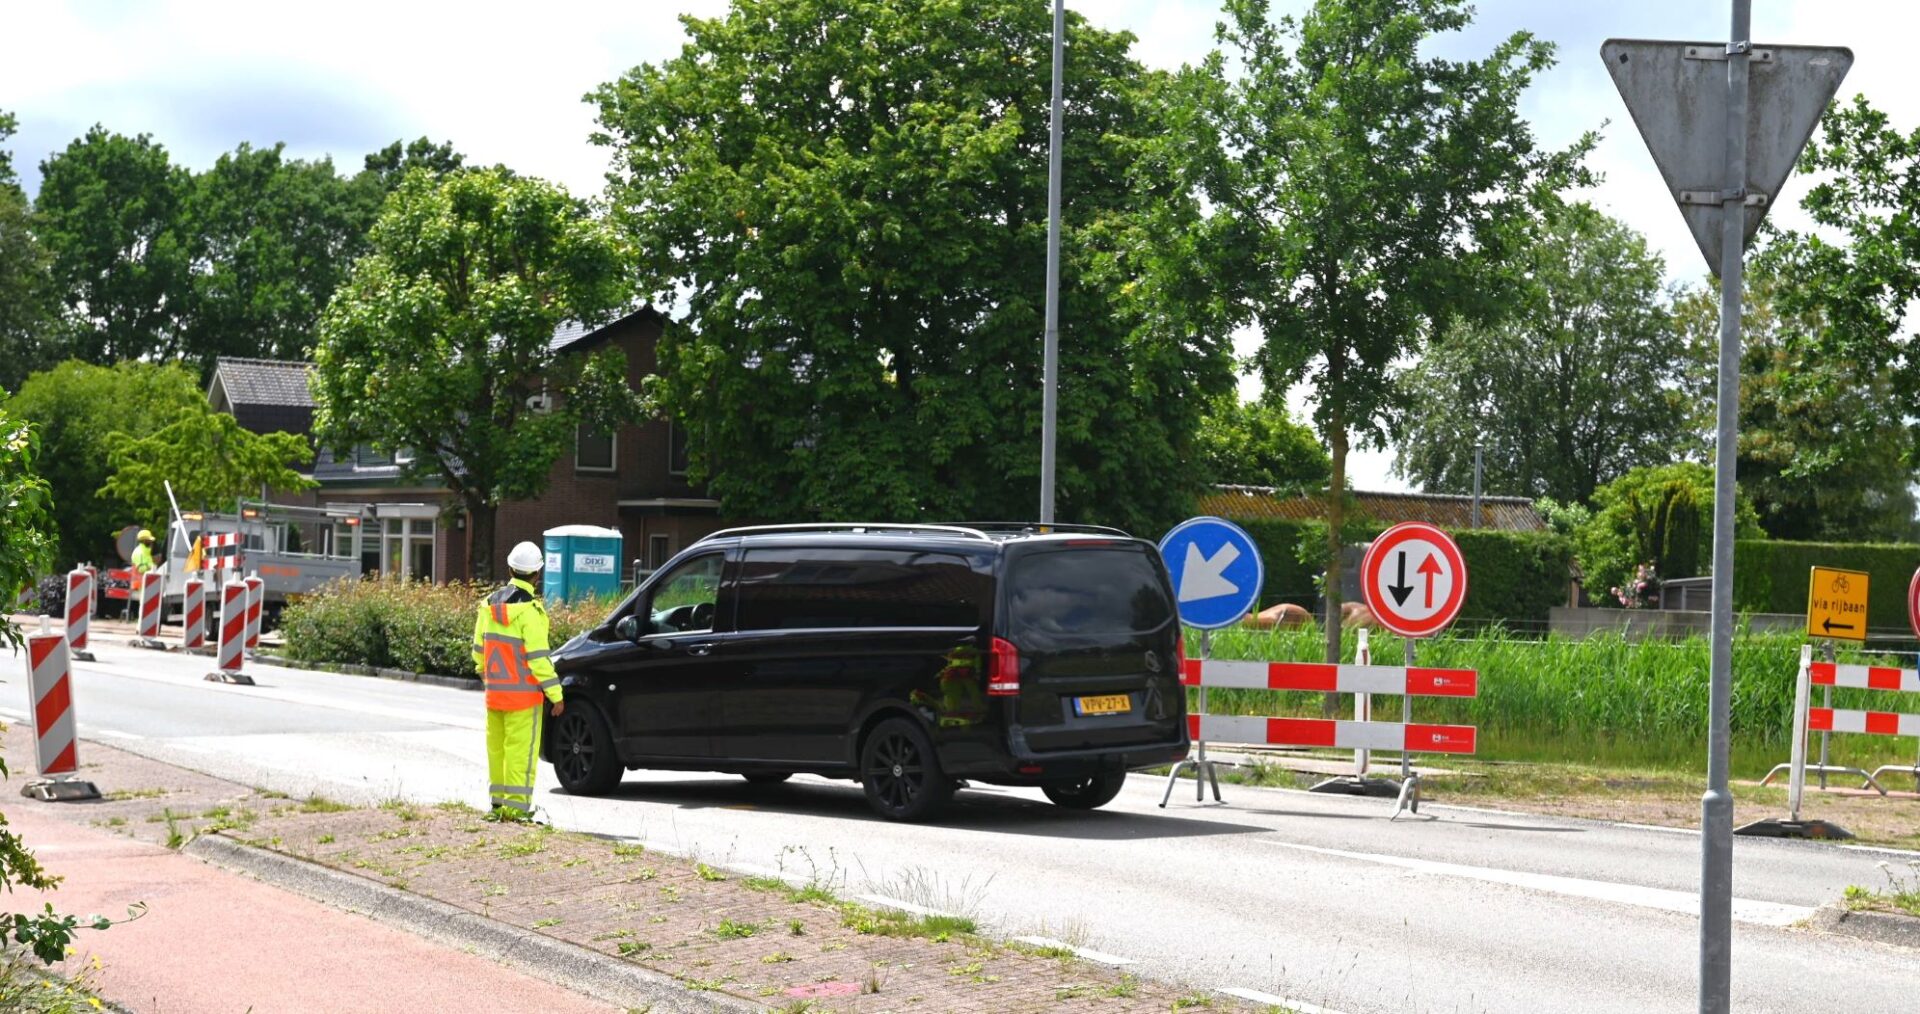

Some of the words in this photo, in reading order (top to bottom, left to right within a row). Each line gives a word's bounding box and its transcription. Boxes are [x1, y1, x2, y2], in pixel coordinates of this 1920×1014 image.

[585, 557, 604, 565] DIXI
[1814, 598, 1828, 609] via
[1831, 599, 1865, 615] rijbaan
[1082, 696, 1128, 711] VPV-27-X
